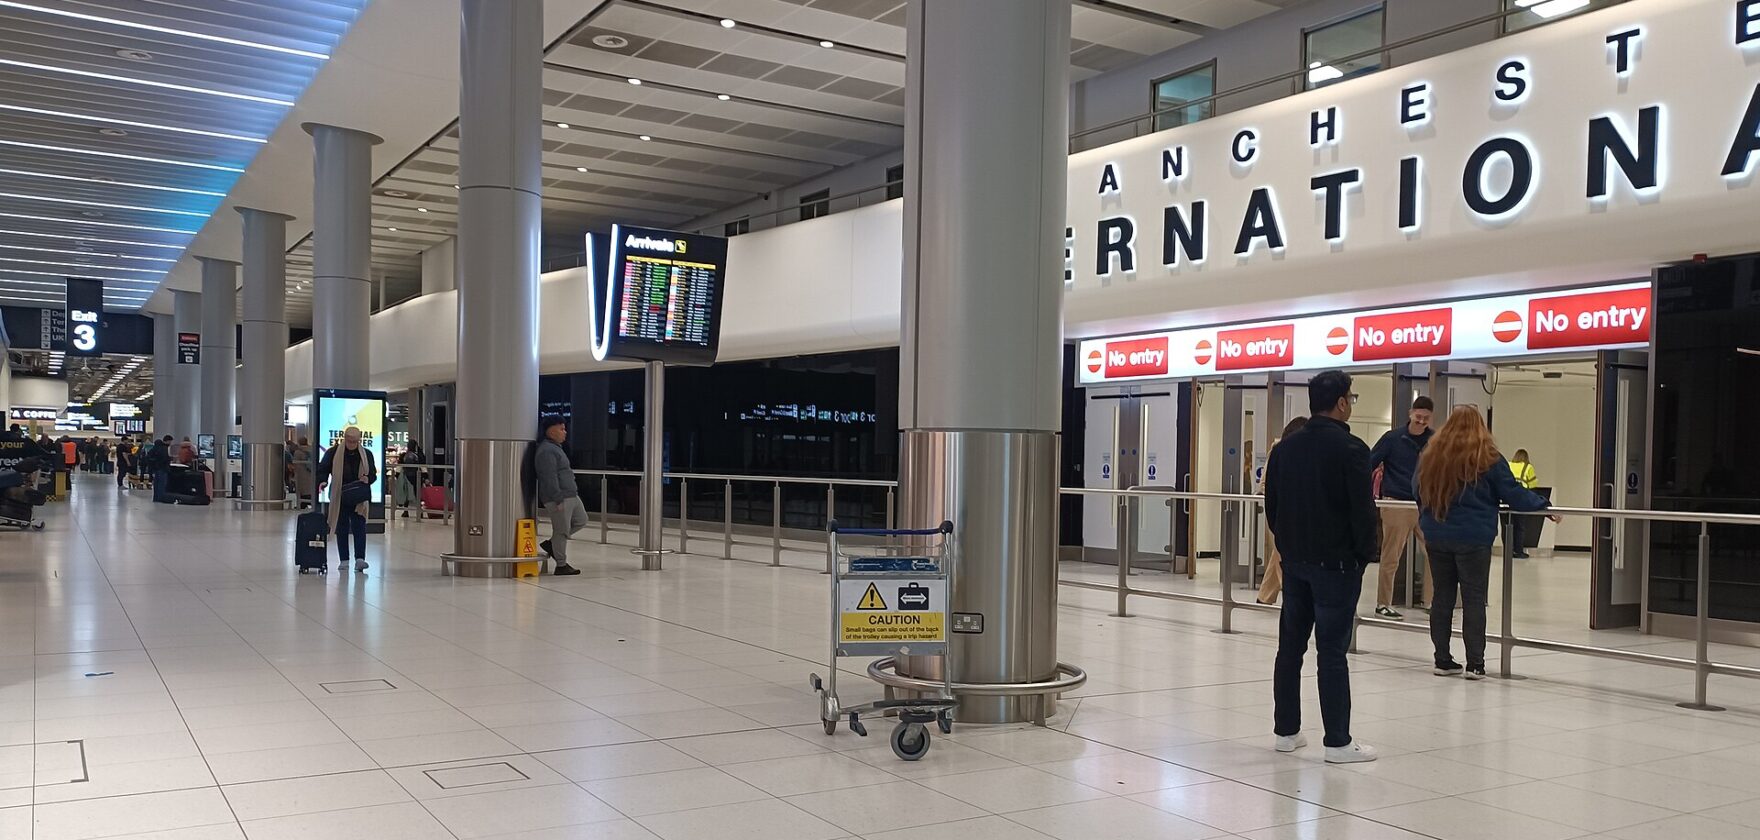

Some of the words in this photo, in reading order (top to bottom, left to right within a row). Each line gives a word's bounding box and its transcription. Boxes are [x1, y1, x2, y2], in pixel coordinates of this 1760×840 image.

[1065, 82, 1760, 281] RNATION
[625, 234, 674, 252] Arrivals
[72, 310, 98, 323] Exit
[1536, 309, 1569, 333] No
[1577, 305, 1647, 331] entry
[73, 324, 97, 351] 3
[1359, 326, 1386, 347] No
[1391, 322, 1445, 346] entry
[1108, 350, 1127, 367] No
[1129, 347, 1164, 367] entry
[1220, 340, 1242, 358] No
[1246, 337, 1289, 358] entry
[329, 430, 373, 439] TERAL
[0, 441, 25, 449] your
[868, 615, 920, 625] CAUTION
